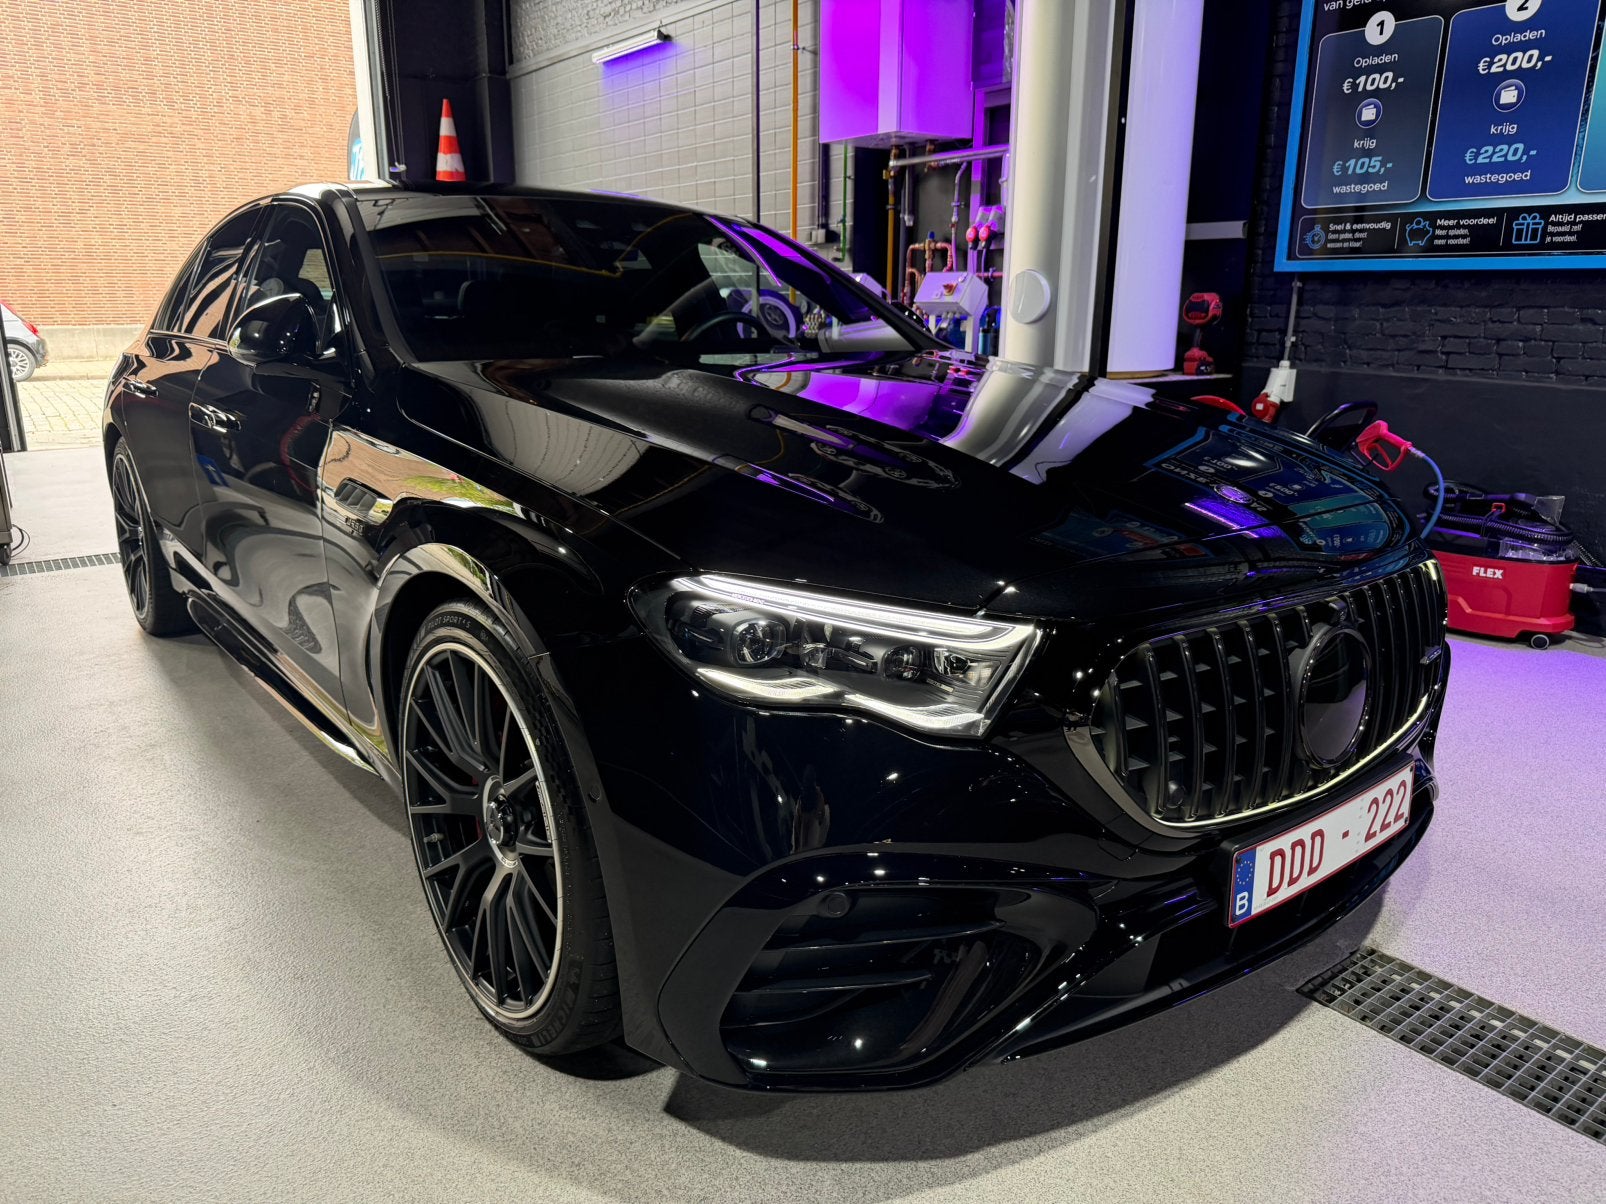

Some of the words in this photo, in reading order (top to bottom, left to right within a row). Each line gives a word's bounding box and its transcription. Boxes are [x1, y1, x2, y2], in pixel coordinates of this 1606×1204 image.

[1324, 0, 1343, 11] van
[1346, 0, 1372, 8] ge
[1516, 0, 1530, 12] 2
[1376, 20, 1385, 36] 1
[1492, 28, 1546, 46] Opladen
[1354, 52, 1398, 68] Opladen
[1490, 122, 1517, 136] krijg
[1354, 137, 1376, 150] krijg
[1464, 170, 1530, 184] wastegoed
[1332, 181, 1388, 194] wastegoed
[1460, 216, 1497, 225] voordeel
[1549, 213, 1575, 223] Altijd
[1352, 221, 1391, 230] eenvoudig
[1545, 235, 1552, 244] je
[1472, 566, 1504, 579] FLEX
[1266, 828, 1325, 898] DDD
[1364, 779, 1407, 843] 222
[1235, 891, 1249, 916] B
